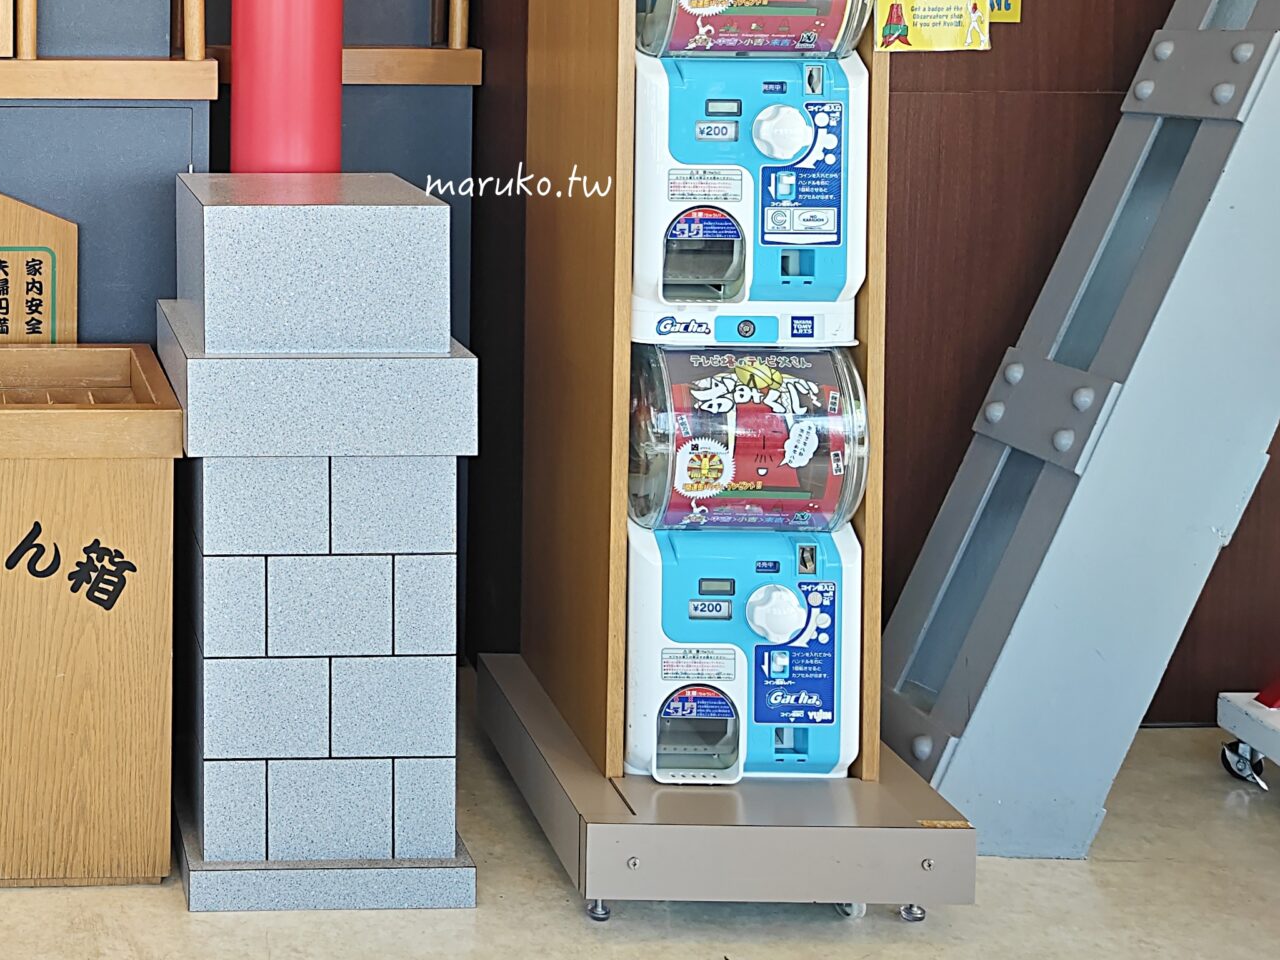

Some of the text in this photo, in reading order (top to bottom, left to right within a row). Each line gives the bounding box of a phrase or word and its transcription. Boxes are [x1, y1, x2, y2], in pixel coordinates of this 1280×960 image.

[698, 126, 728, 136] ¥200
[25, 258, 44, 336] 家内安全
[692, 603, 723, 613] ¥200
